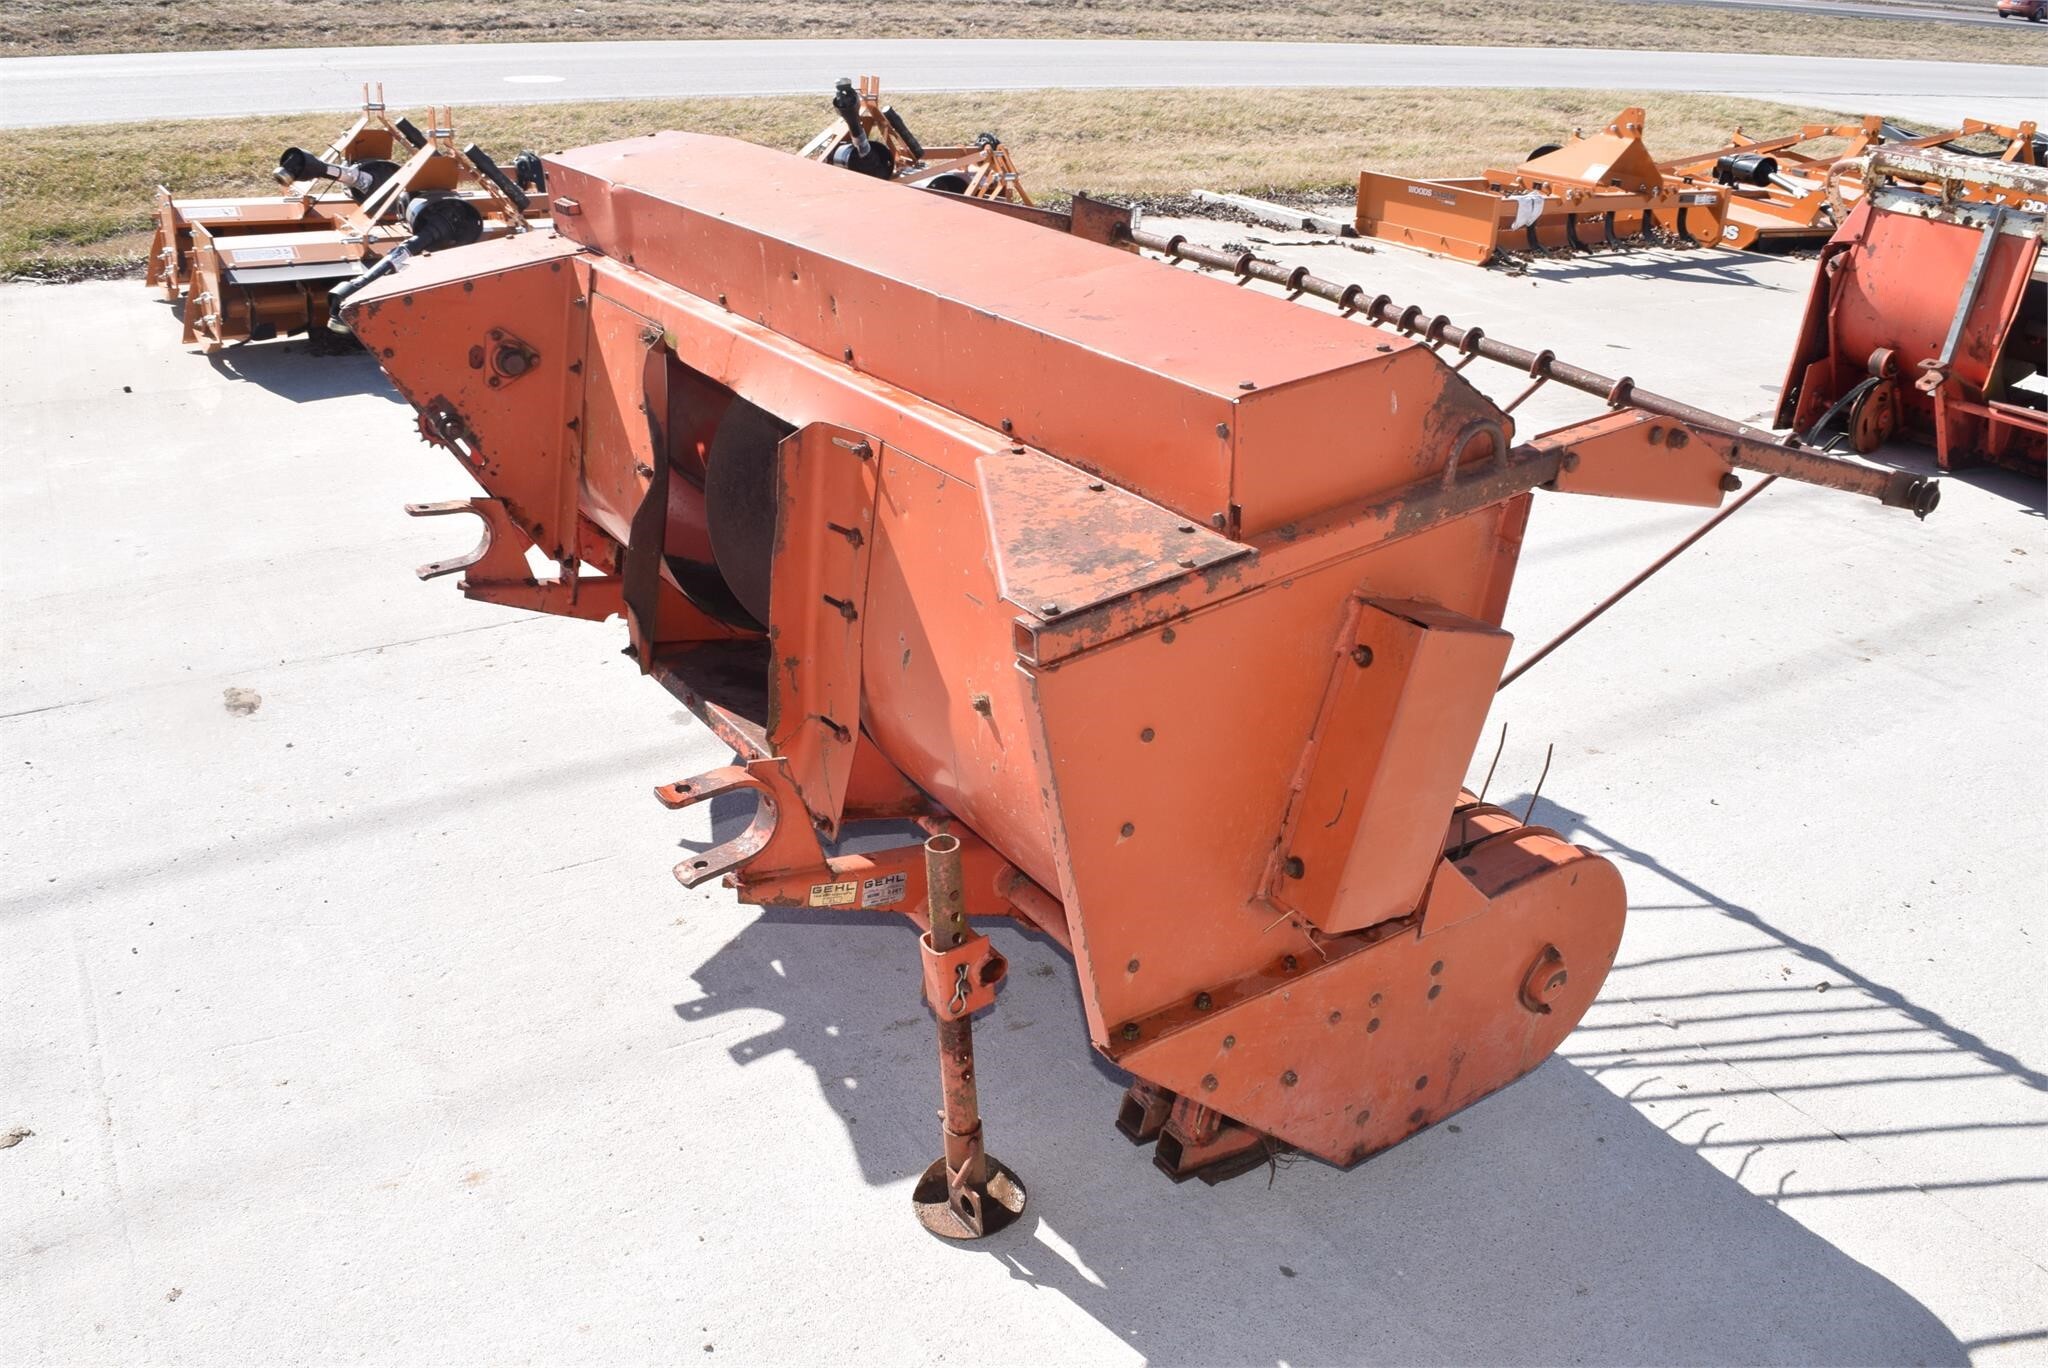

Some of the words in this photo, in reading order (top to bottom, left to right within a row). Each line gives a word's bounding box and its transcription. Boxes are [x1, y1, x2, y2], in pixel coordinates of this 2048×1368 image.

[1408, 185, 1433, 197] WOODS
[864, 874, 905, 889] GEHL
[812, 883, 855, 894] GEHL
